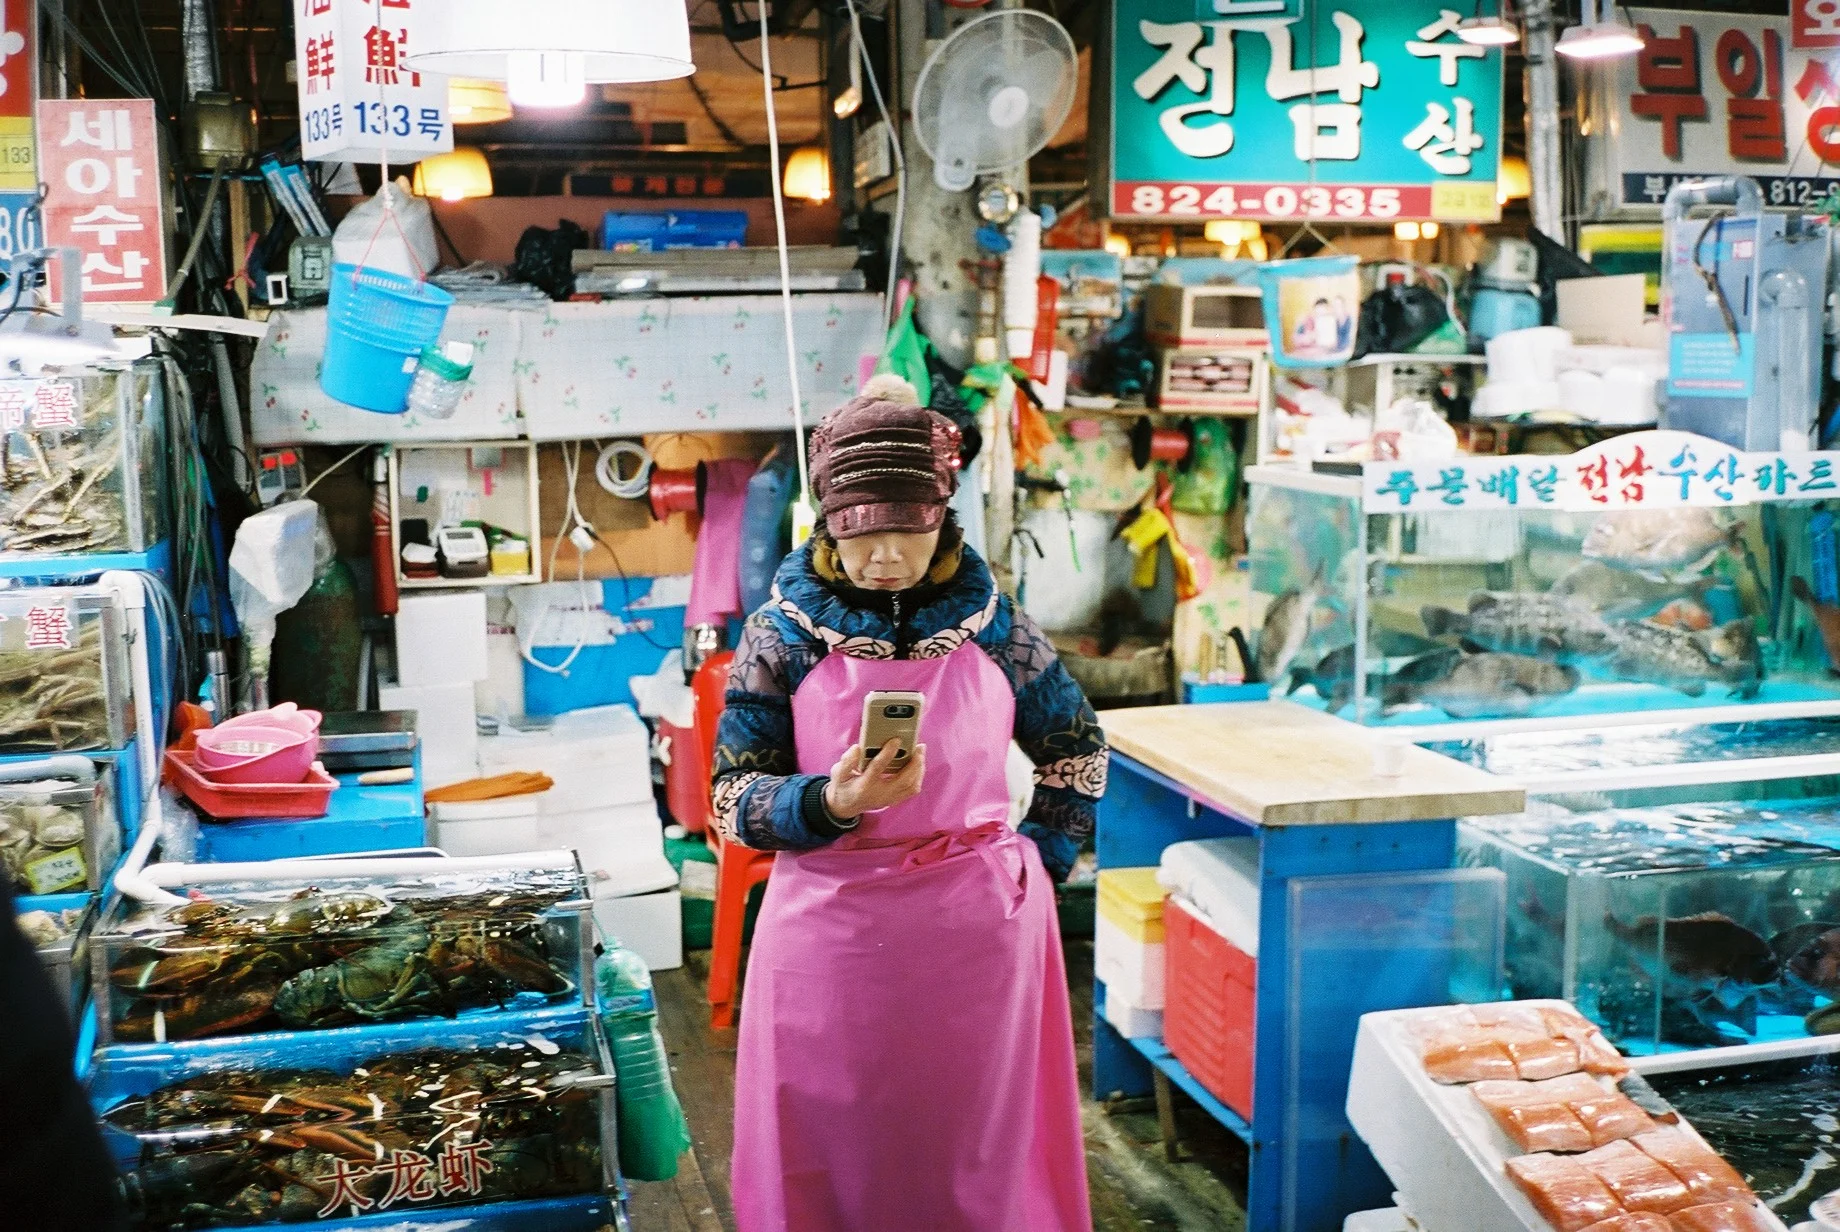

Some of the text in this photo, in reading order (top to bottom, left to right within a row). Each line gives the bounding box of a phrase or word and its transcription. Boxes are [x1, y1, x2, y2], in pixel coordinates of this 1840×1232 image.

[354, 101, 443, 142] 133号
[1402, 9, 1486, 176] 수산
[1131, 186, 1402, 218] 824-0335
[314, 1139, 494, 1218] 大龙虾
